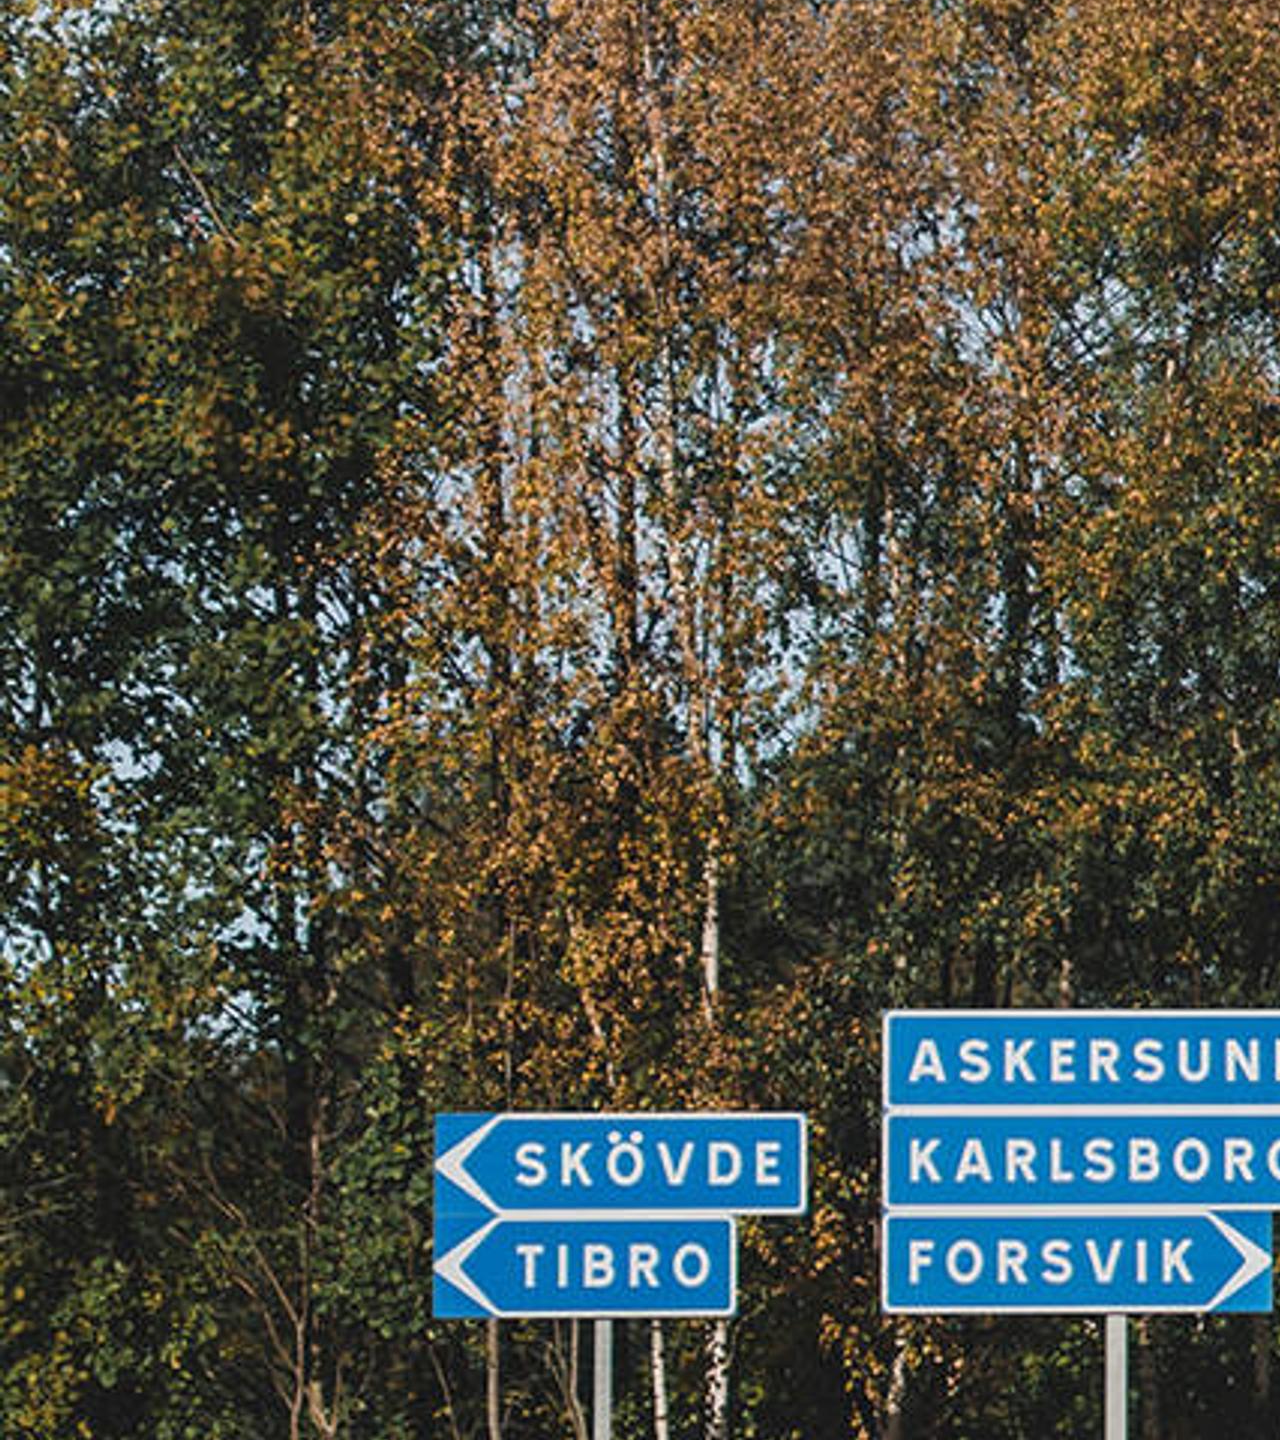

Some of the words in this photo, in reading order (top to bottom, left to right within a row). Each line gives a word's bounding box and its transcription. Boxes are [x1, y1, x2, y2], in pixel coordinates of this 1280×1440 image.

[515, 1130, 781, 1187] SKÖVDE
[516, 1243, 710, 1288] TIBRO
[909, 1238, 1193, 1285] FORSVIK
